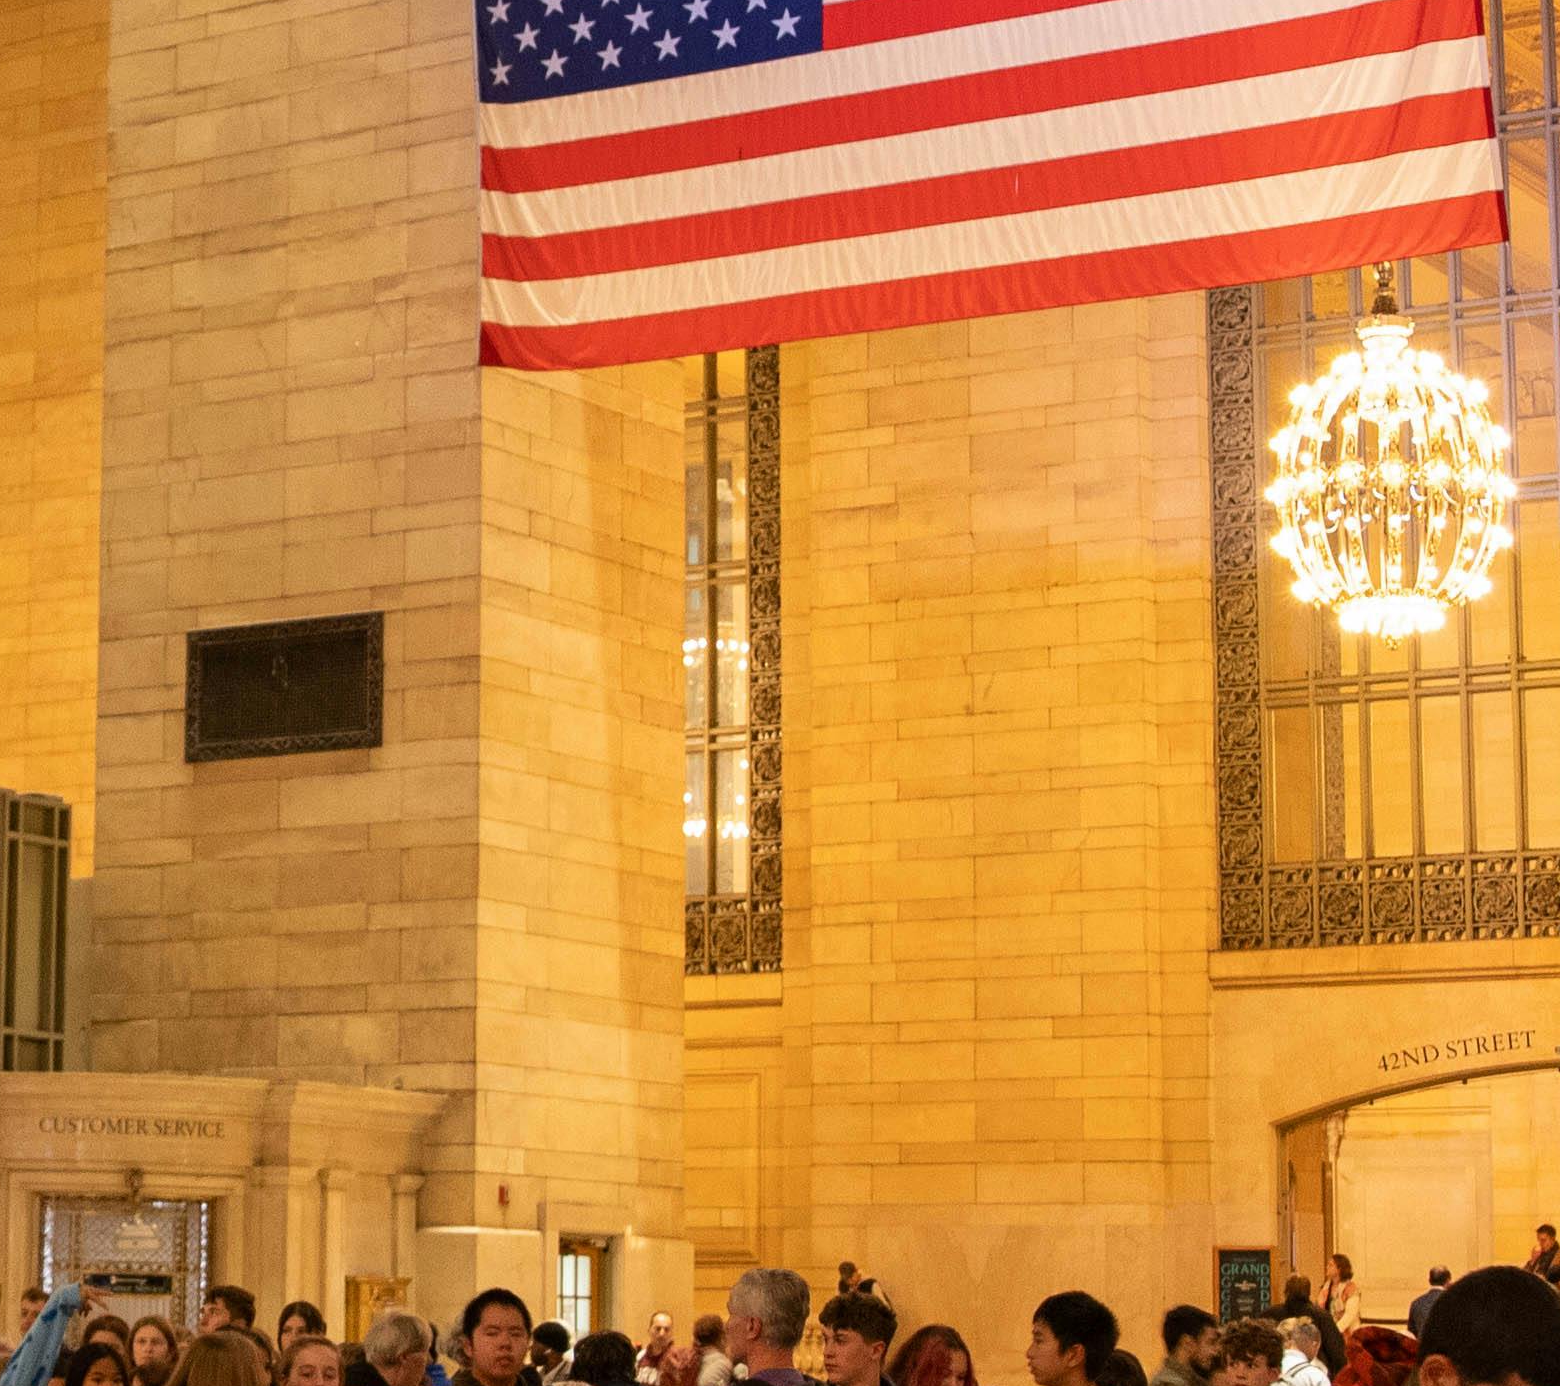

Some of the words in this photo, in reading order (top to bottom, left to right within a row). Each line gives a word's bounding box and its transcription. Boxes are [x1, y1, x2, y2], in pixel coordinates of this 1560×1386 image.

[1377, 1044, 1440, 1072] 42ND
[1445, 1030, 1537, 1060] STREET
[38, 1115, 148, 1135] CUSTOMER
[153, 1118, 226, 1139] SERVICE
[1221, 1263, 1270, 1276] GRAND
